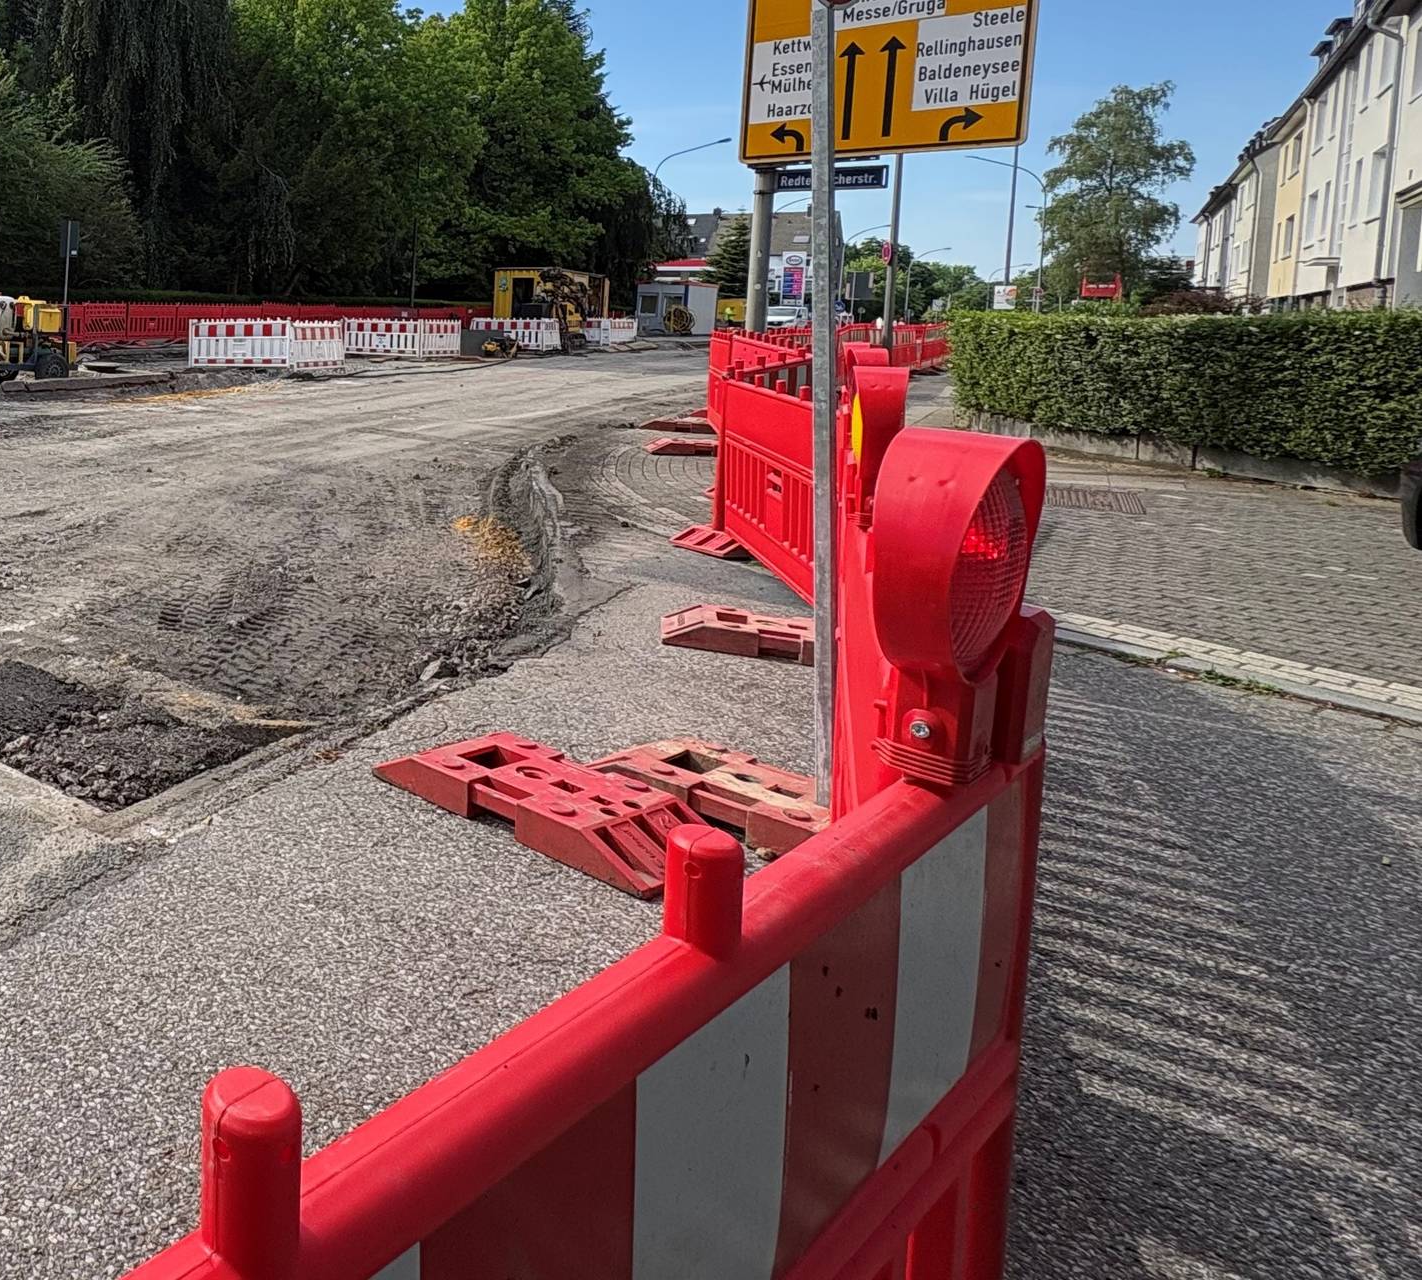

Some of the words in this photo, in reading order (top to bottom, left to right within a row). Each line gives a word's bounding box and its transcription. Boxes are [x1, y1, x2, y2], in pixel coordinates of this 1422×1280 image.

[842, 0, 945, 23] Messe/Gruga
[973, 10, 1025, 28] Steele
[773, 39, 812, 55] Kettw
[916, 33, 1022, 58] Rellinghausen
[918, 59, 1020, 82] Baldeneysee
[771, 77, 812, 94] Mülhe
[924, 88, 958, 104] Villa
[969, 81, 1016, 102] Hügel
[767, 103, 812, 118] Haarz
[780, 173, 878, 187] Redtecherstr.
